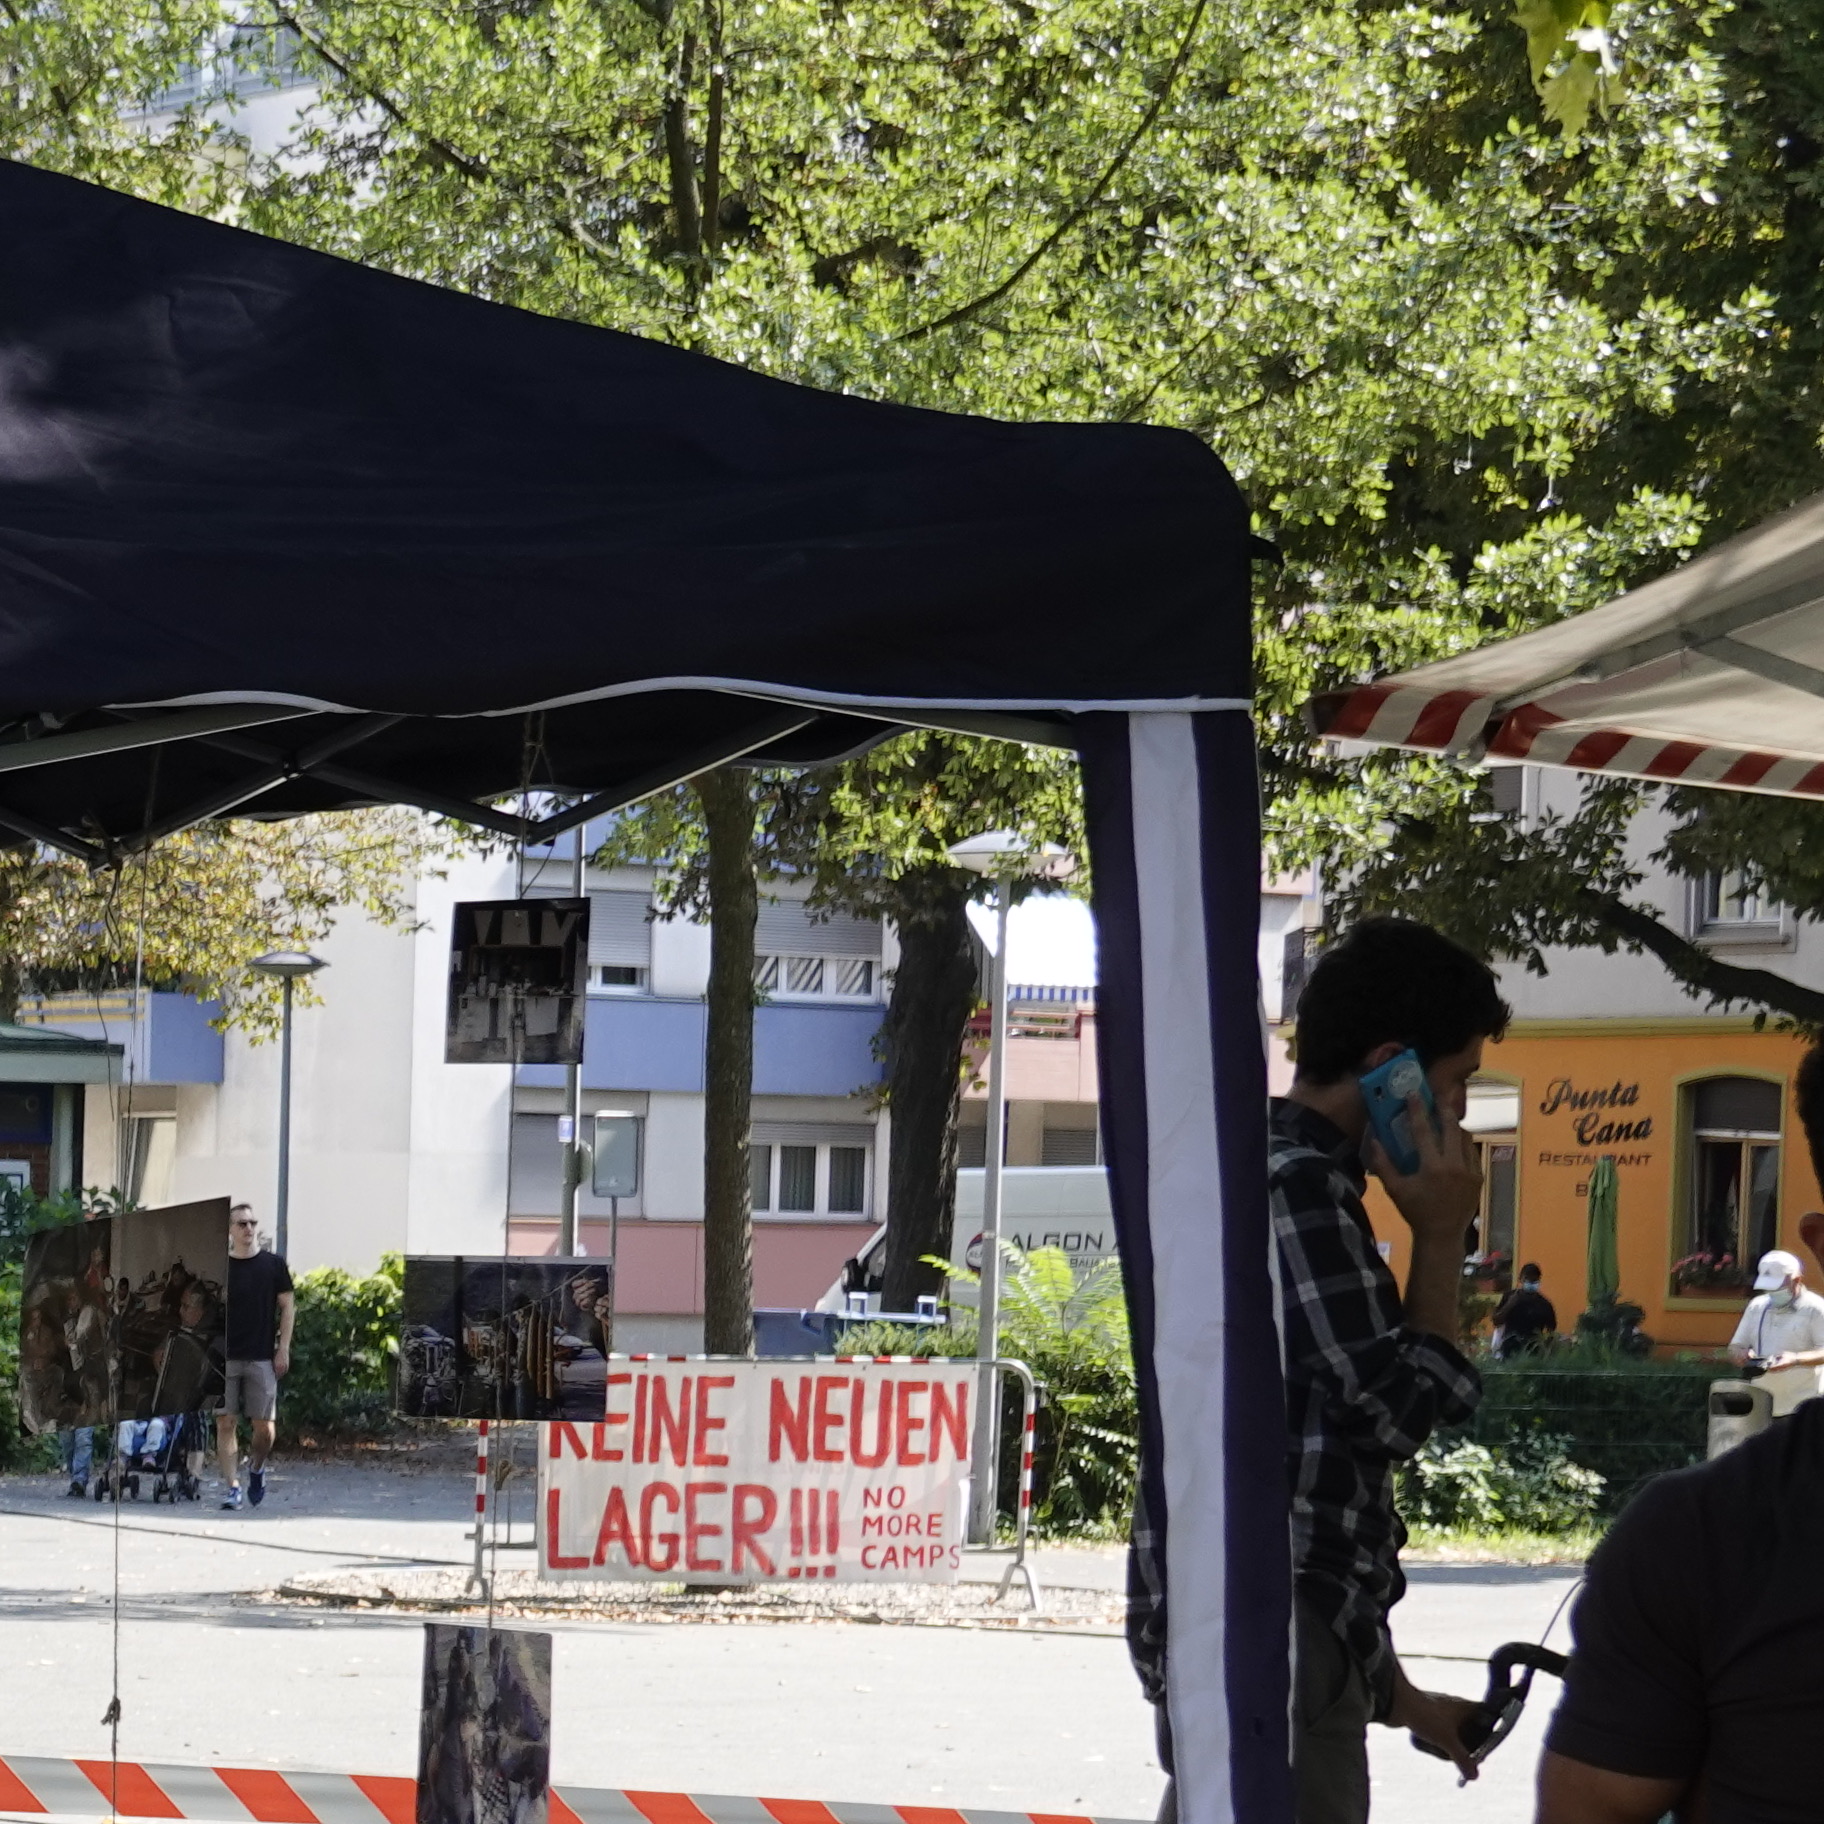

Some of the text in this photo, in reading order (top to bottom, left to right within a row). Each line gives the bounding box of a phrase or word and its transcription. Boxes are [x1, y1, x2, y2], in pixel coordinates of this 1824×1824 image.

[1539, 1079, 1639, 1115] Punta
[1573, 1112, 1653, 1147] Cana
[768, 1375, 970, 1468] NEUEN
[862, 1486, 906, 1510] NO
[547, 1481, 840, 1579] LAGER!!!
[861, 1513, 944, 1538] MORE
[860, 1544, 961, 1571] CAMPS
